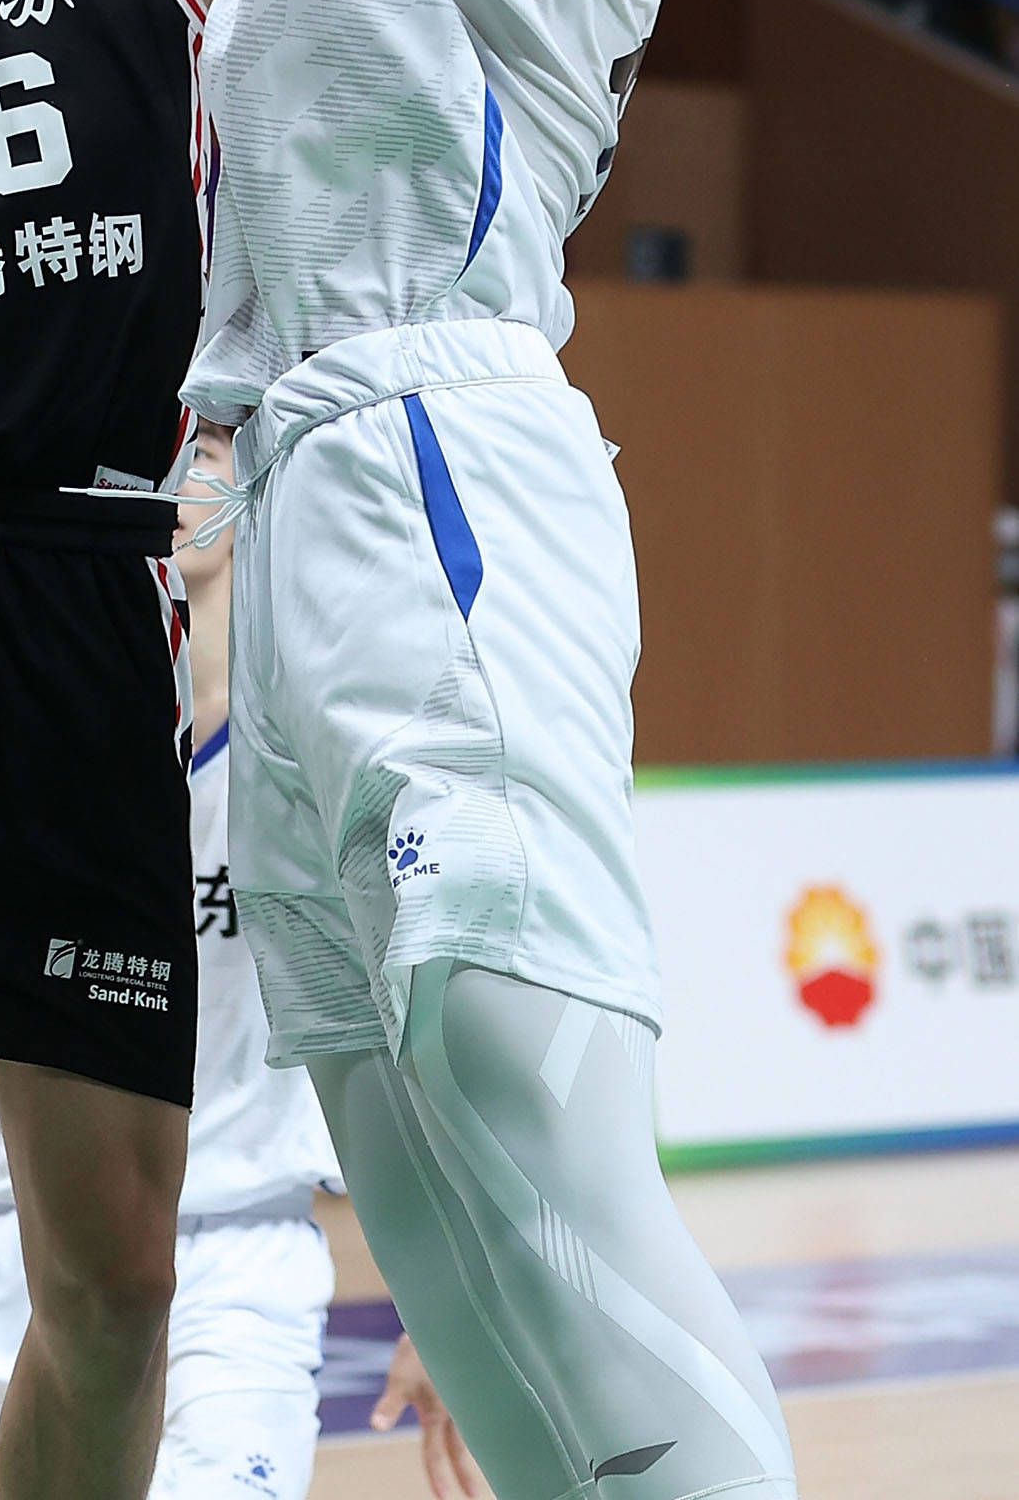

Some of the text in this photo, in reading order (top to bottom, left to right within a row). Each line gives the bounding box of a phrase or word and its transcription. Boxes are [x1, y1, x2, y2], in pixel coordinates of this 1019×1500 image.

[81, 948, 172, 982] 龙腾特钢
[78, 971, 168, 992] LONGTENG SPECIAL STEEL
